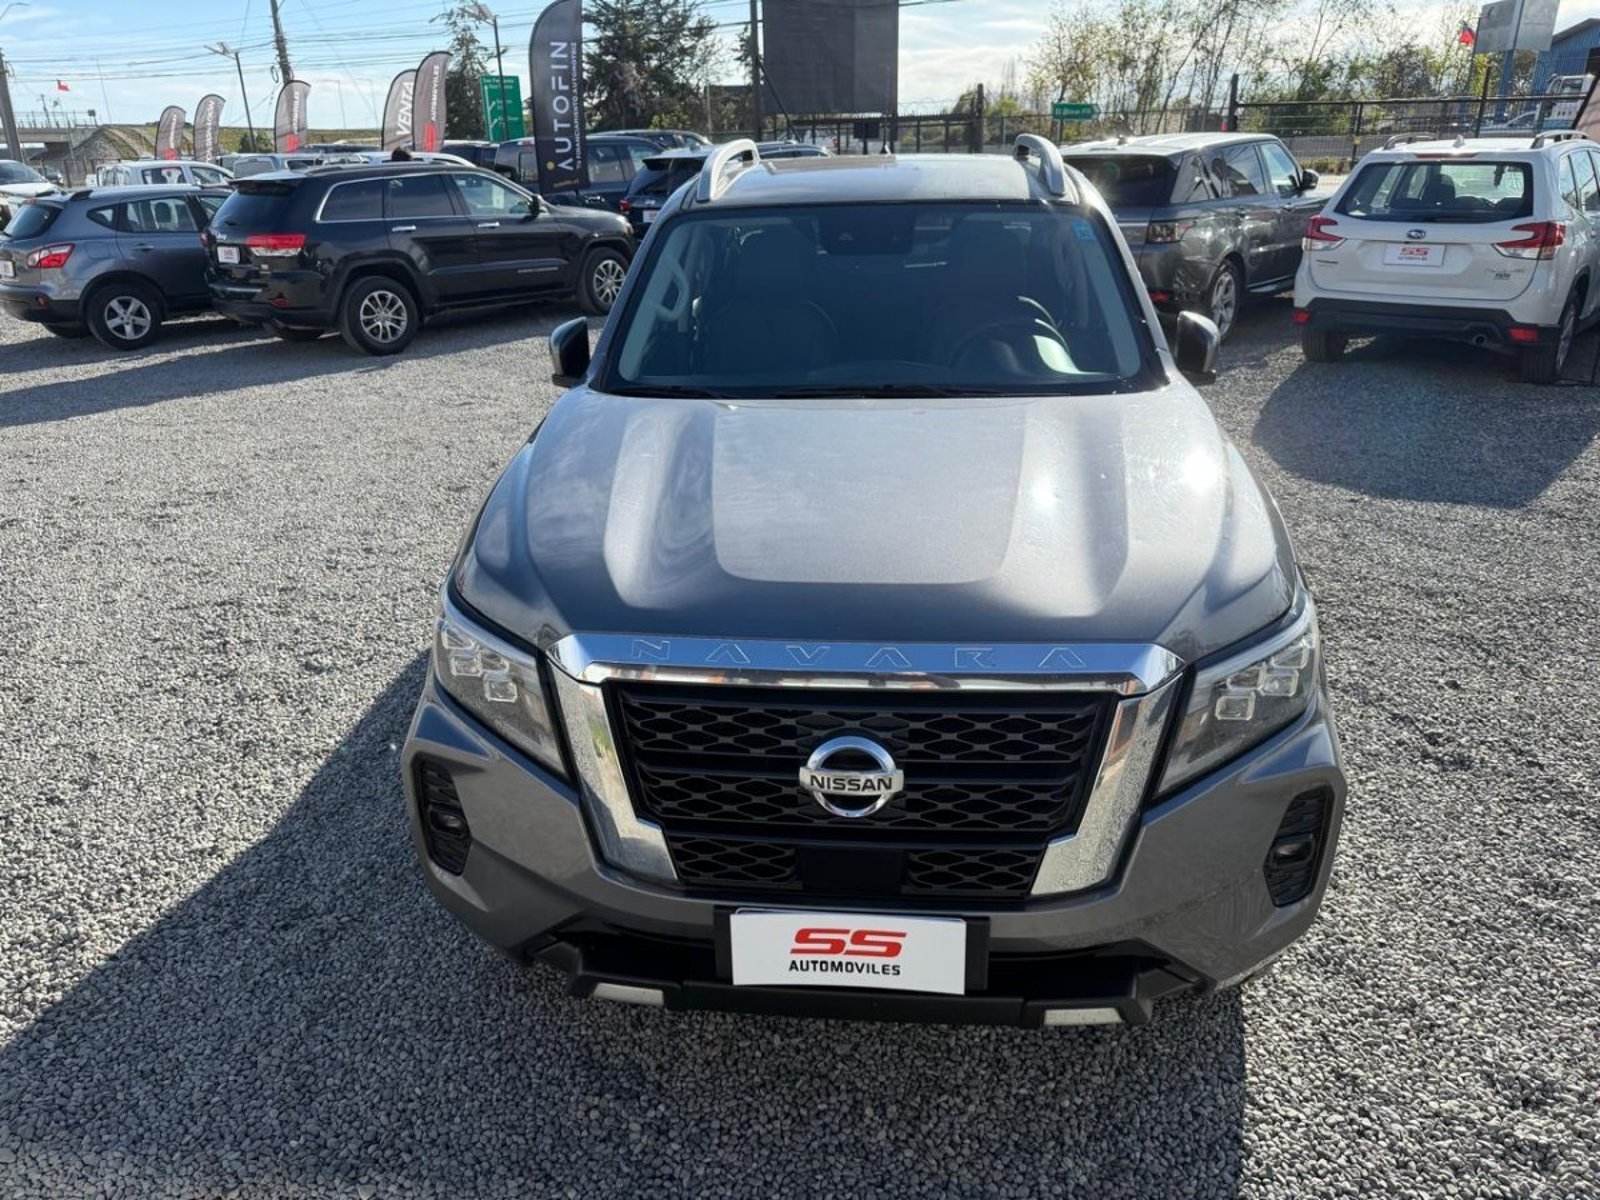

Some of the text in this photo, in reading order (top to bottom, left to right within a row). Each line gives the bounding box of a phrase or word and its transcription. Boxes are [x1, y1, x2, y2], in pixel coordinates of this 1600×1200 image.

[396, 81, 414, 135] VENTA
[550, 42, 574, 171] AUTOFIN
[631, 639, 1087, 669] NAVARA
[810, 775, 893, 792] NISSAN
[790, 927, 907, 958] SS
[788, 959, 901, 976] AUTOMOVILES
